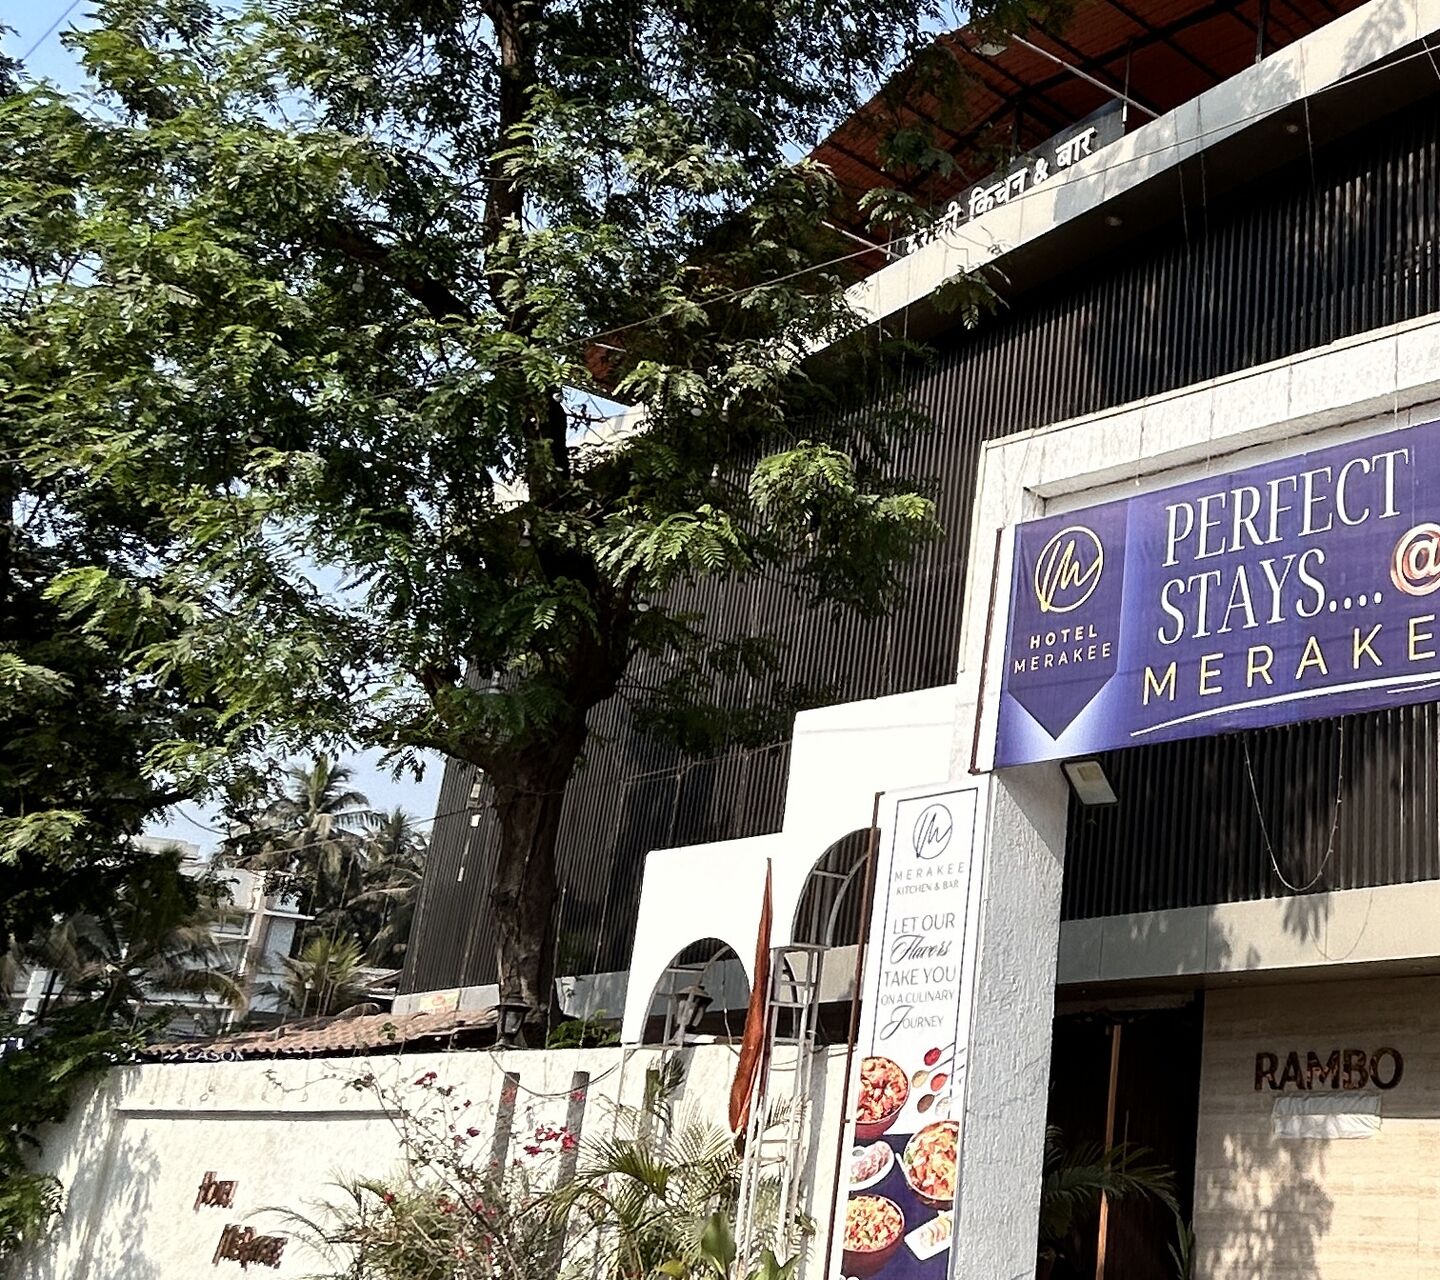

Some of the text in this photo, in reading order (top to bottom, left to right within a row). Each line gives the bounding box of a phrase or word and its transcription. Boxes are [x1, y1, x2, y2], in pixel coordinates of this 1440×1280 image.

[1033, 158, 1049, 184] &
[1055, 126, 1098, 168] बार
[1161, 448, 1409, 568] PERFECT
[1030, 624, 1098, 650] HOTEL
[1013, 642, 1112, 674] MERAKEE
[894, 861, 965, 882] MERAKEE
[896, 879, 959, 896] KITCHEN & BAR
[893, 912, 956, 935] LET OUR
[884, 965, 957, 988] TAKE YOU
[880, 989, 955, 1006] ON A CULINARY
[1254, 1046, 1405, 1091] RAMBO
